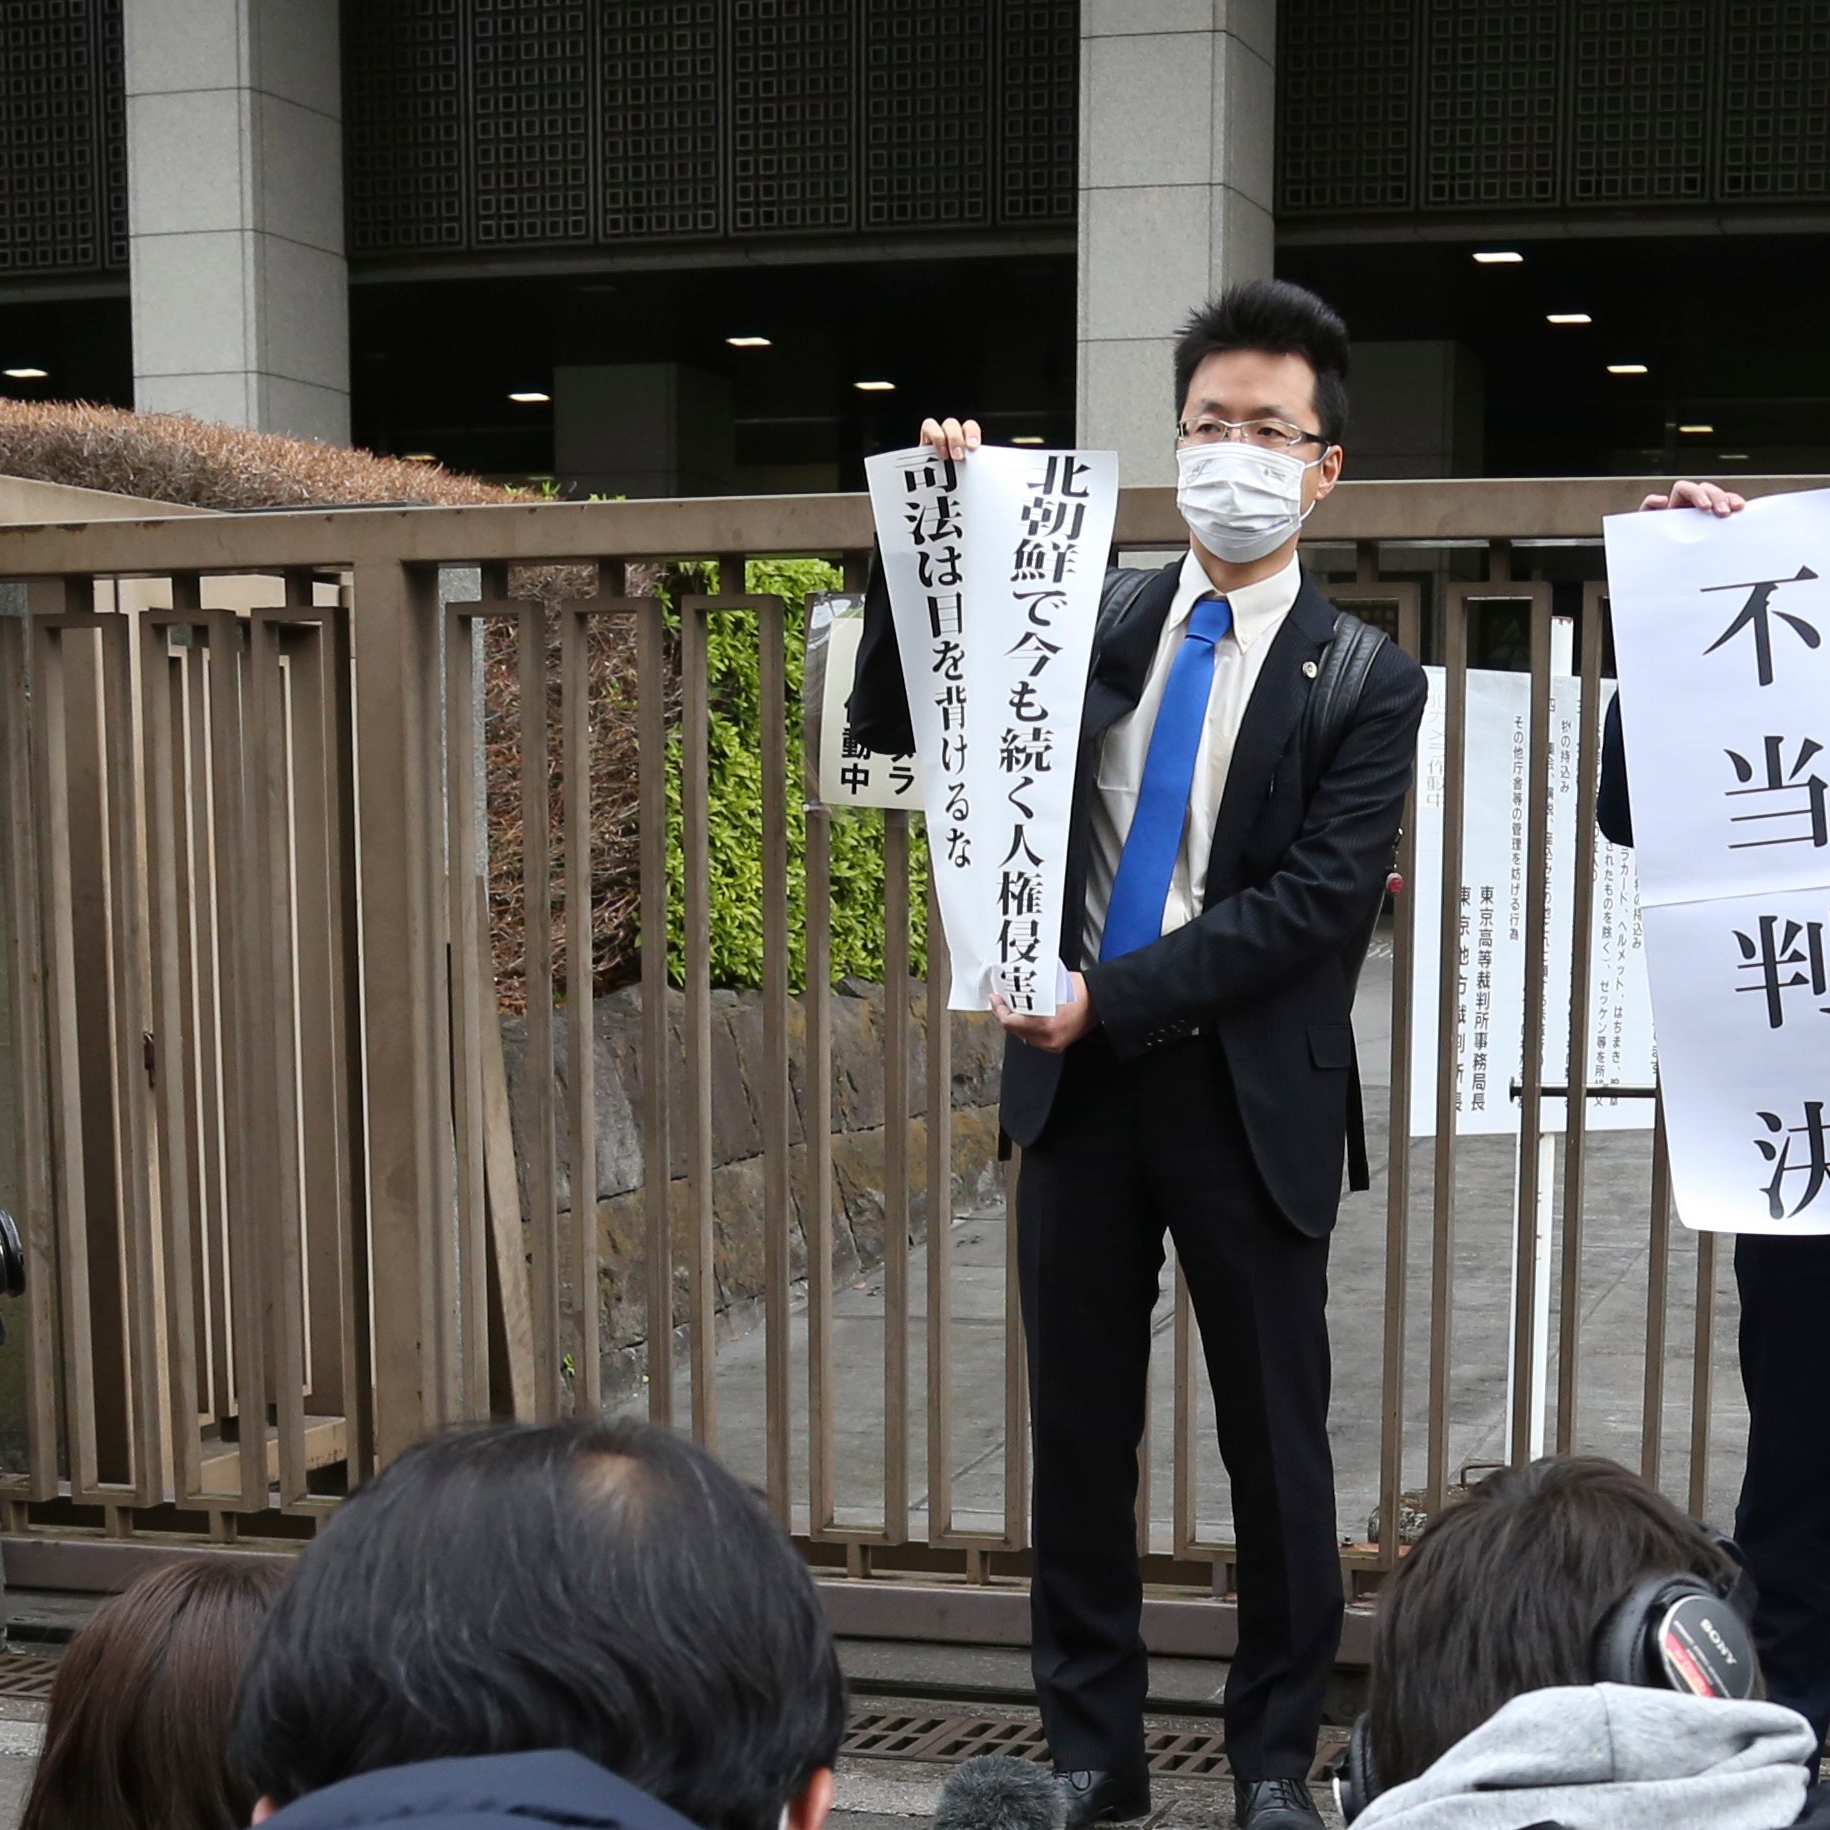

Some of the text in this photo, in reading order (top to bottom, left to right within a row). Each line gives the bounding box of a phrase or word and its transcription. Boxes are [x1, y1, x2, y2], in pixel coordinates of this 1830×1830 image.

[895, 454, 972, 869] 司法は目を背けるな
[995, 454, 1092, 1013] 北朝鮮で今も続く人権侵害
[1699, 1618, 1738, 1665] SONY
